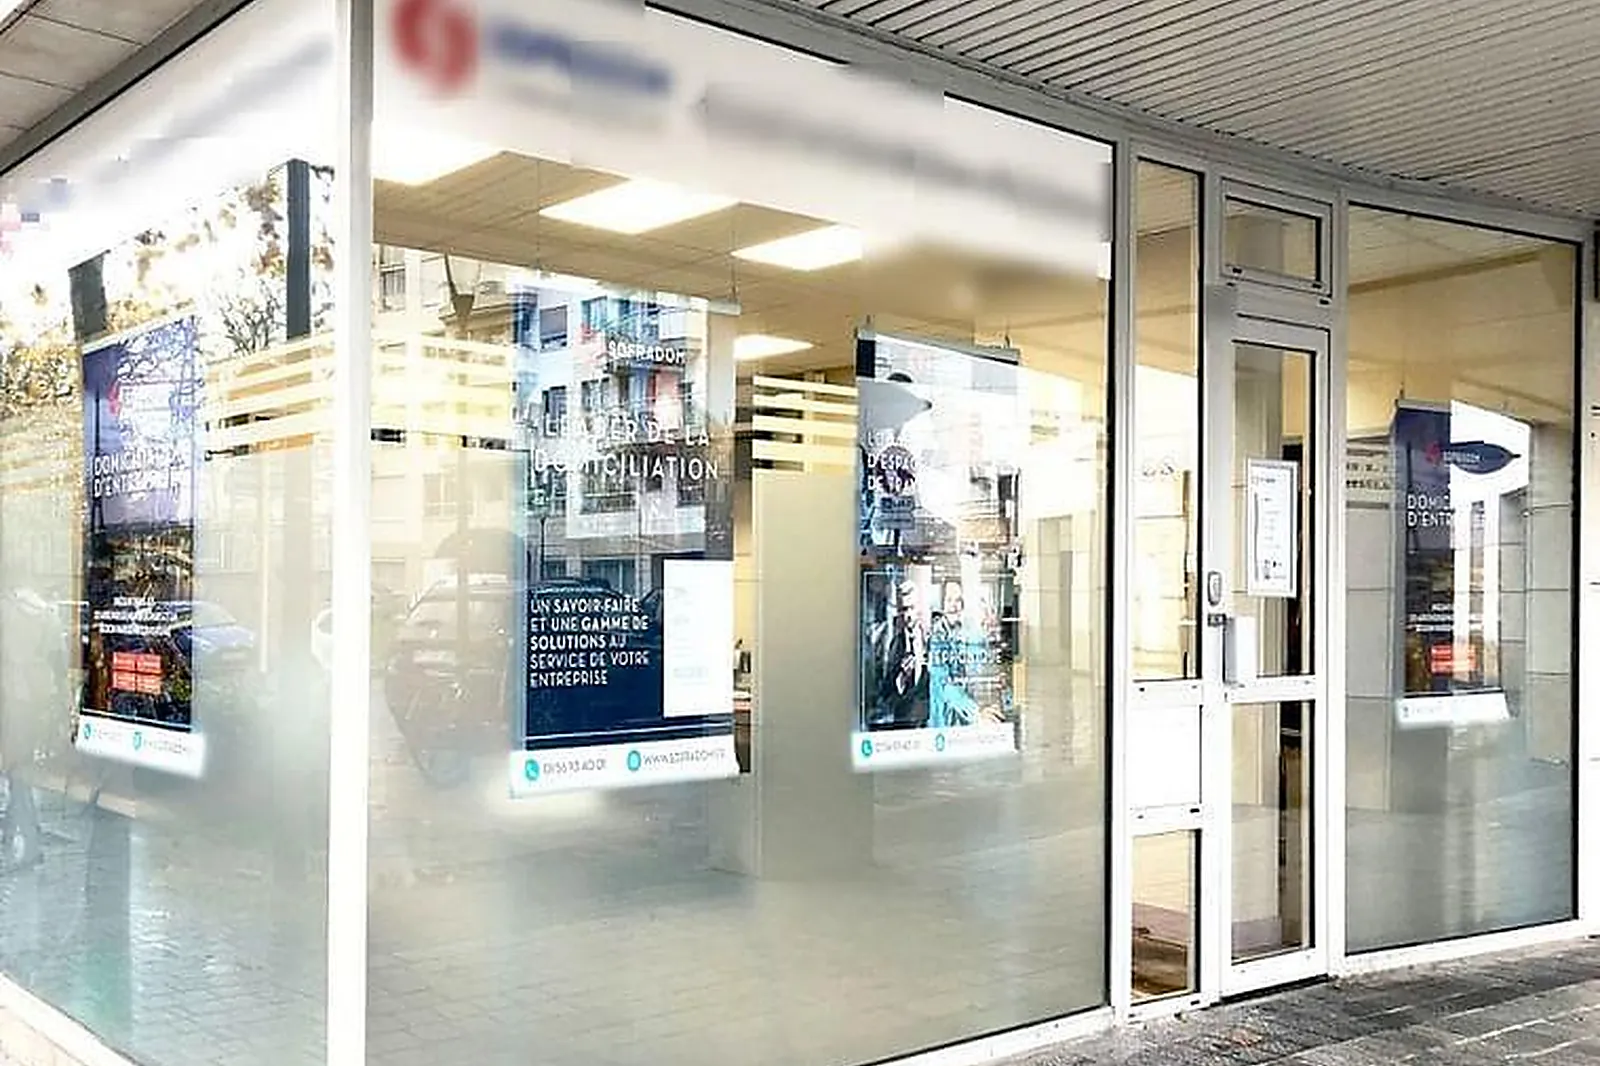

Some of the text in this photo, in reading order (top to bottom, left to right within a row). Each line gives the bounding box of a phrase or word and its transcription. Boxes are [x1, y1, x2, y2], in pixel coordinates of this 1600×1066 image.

[608, 340, 686, 364] SOFRADOM
[648, 420, 676, 445] DE
[686, 426, 710, 447] LA
[530, 599, 550, 614] UN
[530, 615, 649, 632] ET UNE GAMME DE
[530, 634, 627, 651] SOLUTIONS AU
[530, 650, 650, 669] SERVICE DE VOTRE
[530, 669, 608, 688] ENTREPRISE
